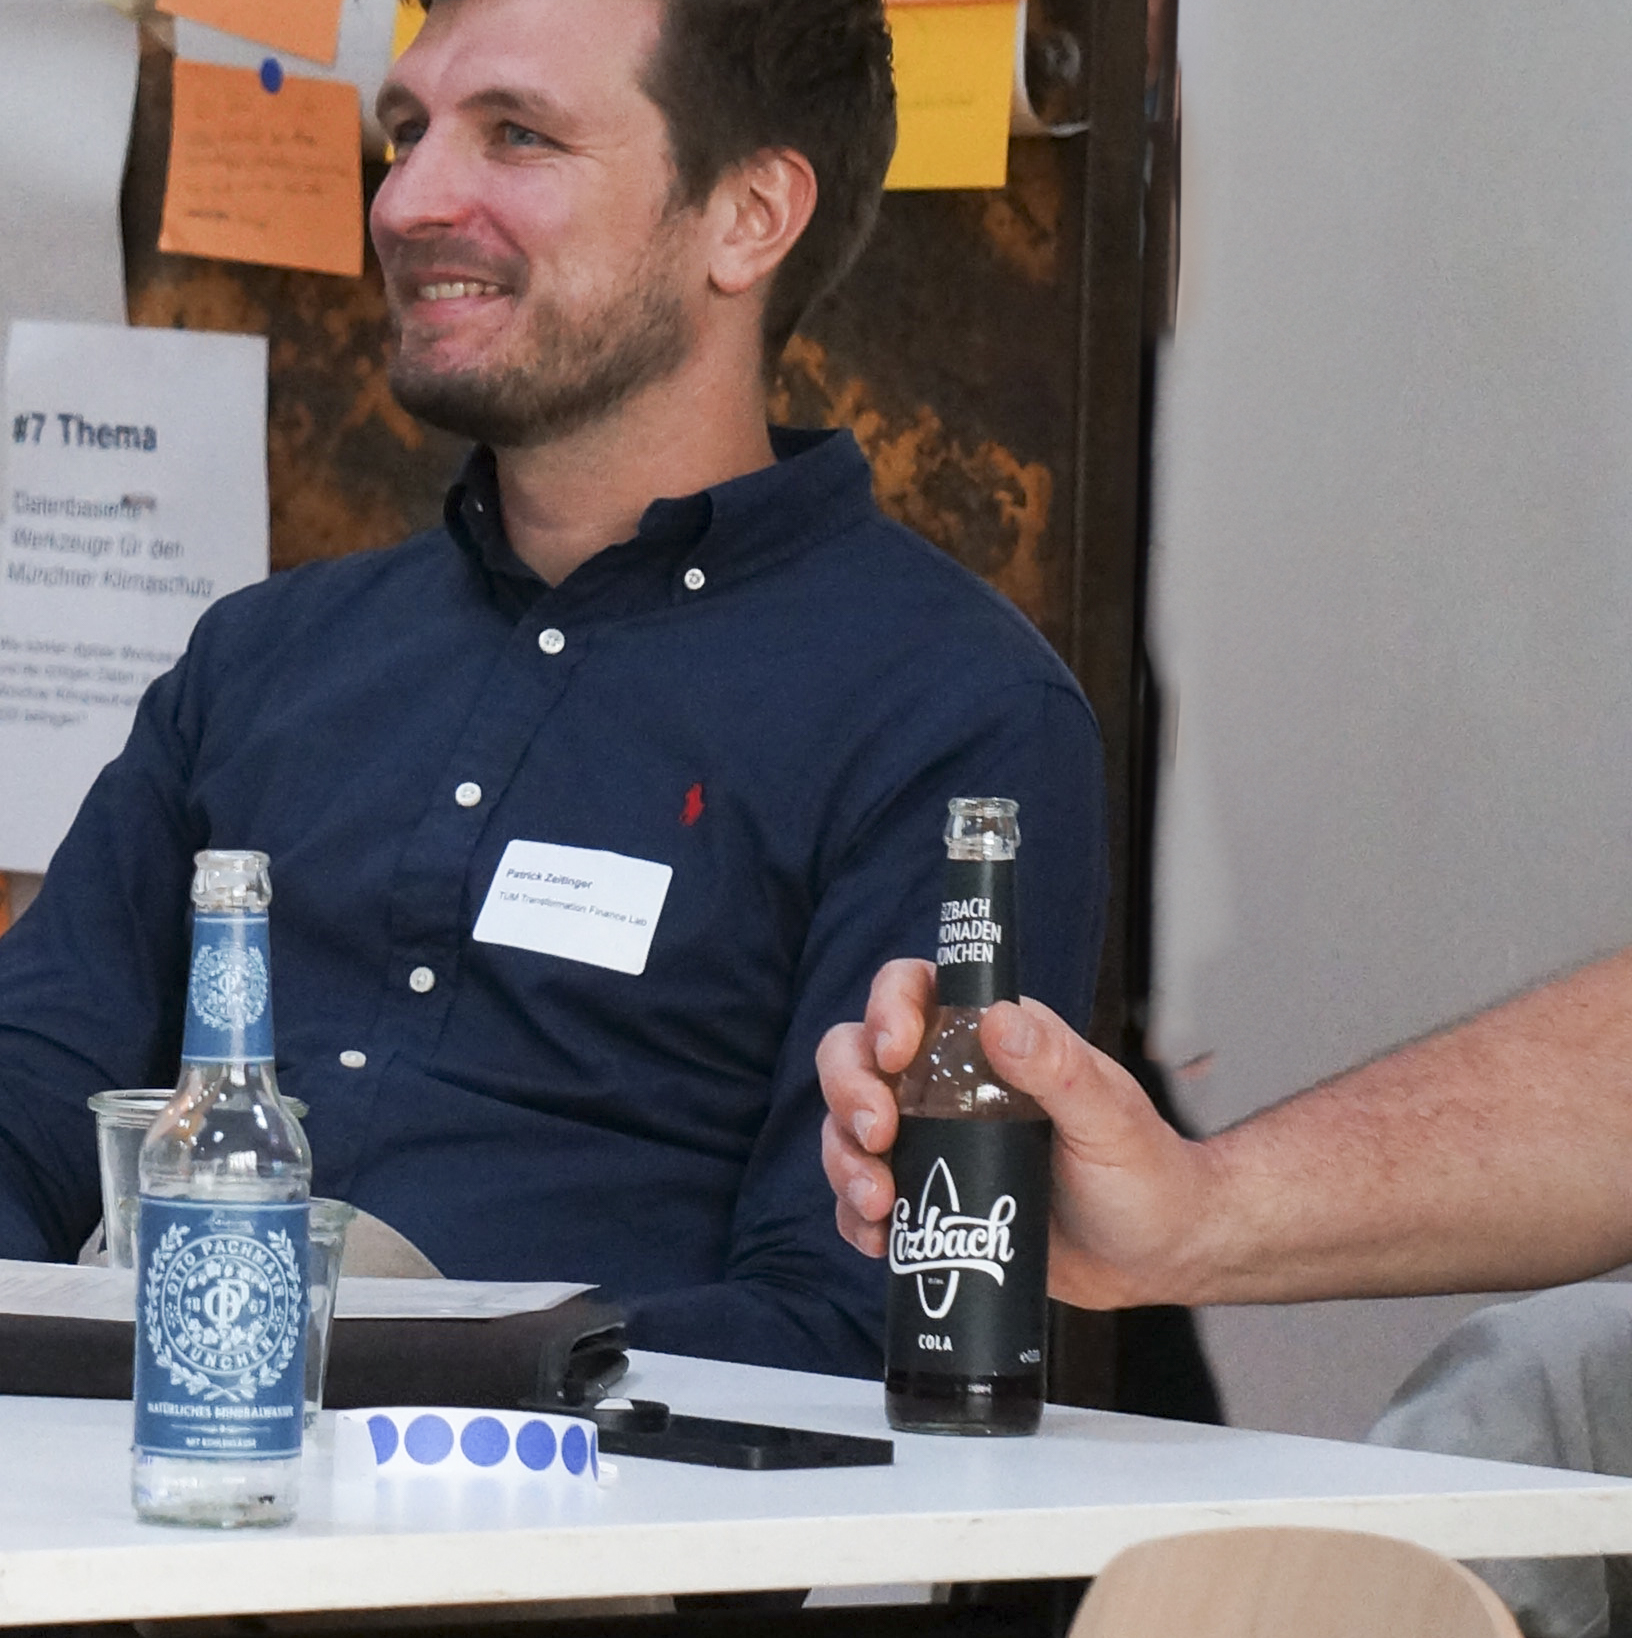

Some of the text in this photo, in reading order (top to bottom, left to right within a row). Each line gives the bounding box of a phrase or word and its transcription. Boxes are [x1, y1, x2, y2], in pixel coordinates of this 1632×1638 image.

[11, 412, 159, 453] #7 Thema
[11, 527, 115, 557] Werkzeuge
[151, 536, 185, 561] den
[7, 561, 93, 589] Münchner
[506, 868, 542, 882] Patrick
[499, 890, 648, 927] TUM Transformation Finance Lab
[889, 1195, 1017, 1287] Eizbach
[167, 1251, 197, 1295] OTTO
[918, 1333, 954, 1352] COLA
